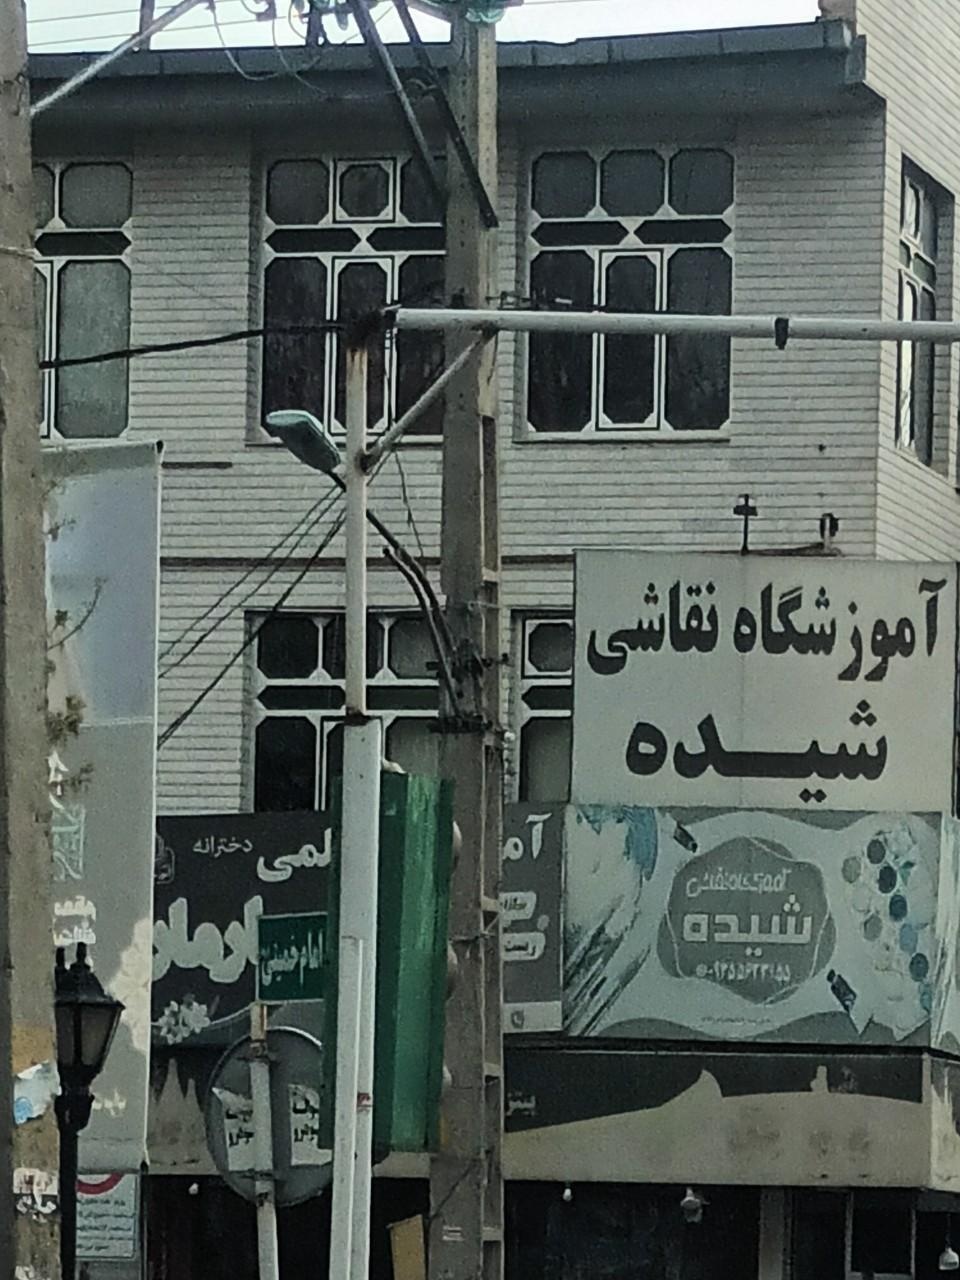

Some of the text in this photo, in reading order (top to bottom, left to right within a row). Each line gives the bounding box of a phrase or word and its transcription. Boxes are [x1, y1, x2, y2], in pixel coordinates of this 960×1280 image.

[587, 578, 947, 681] آموزشگاه نقاشی
[625, 699, 888, 803] شیده
[192, 835, 254, 859] دخترانه
[683, 893, 813, 957] شیده
